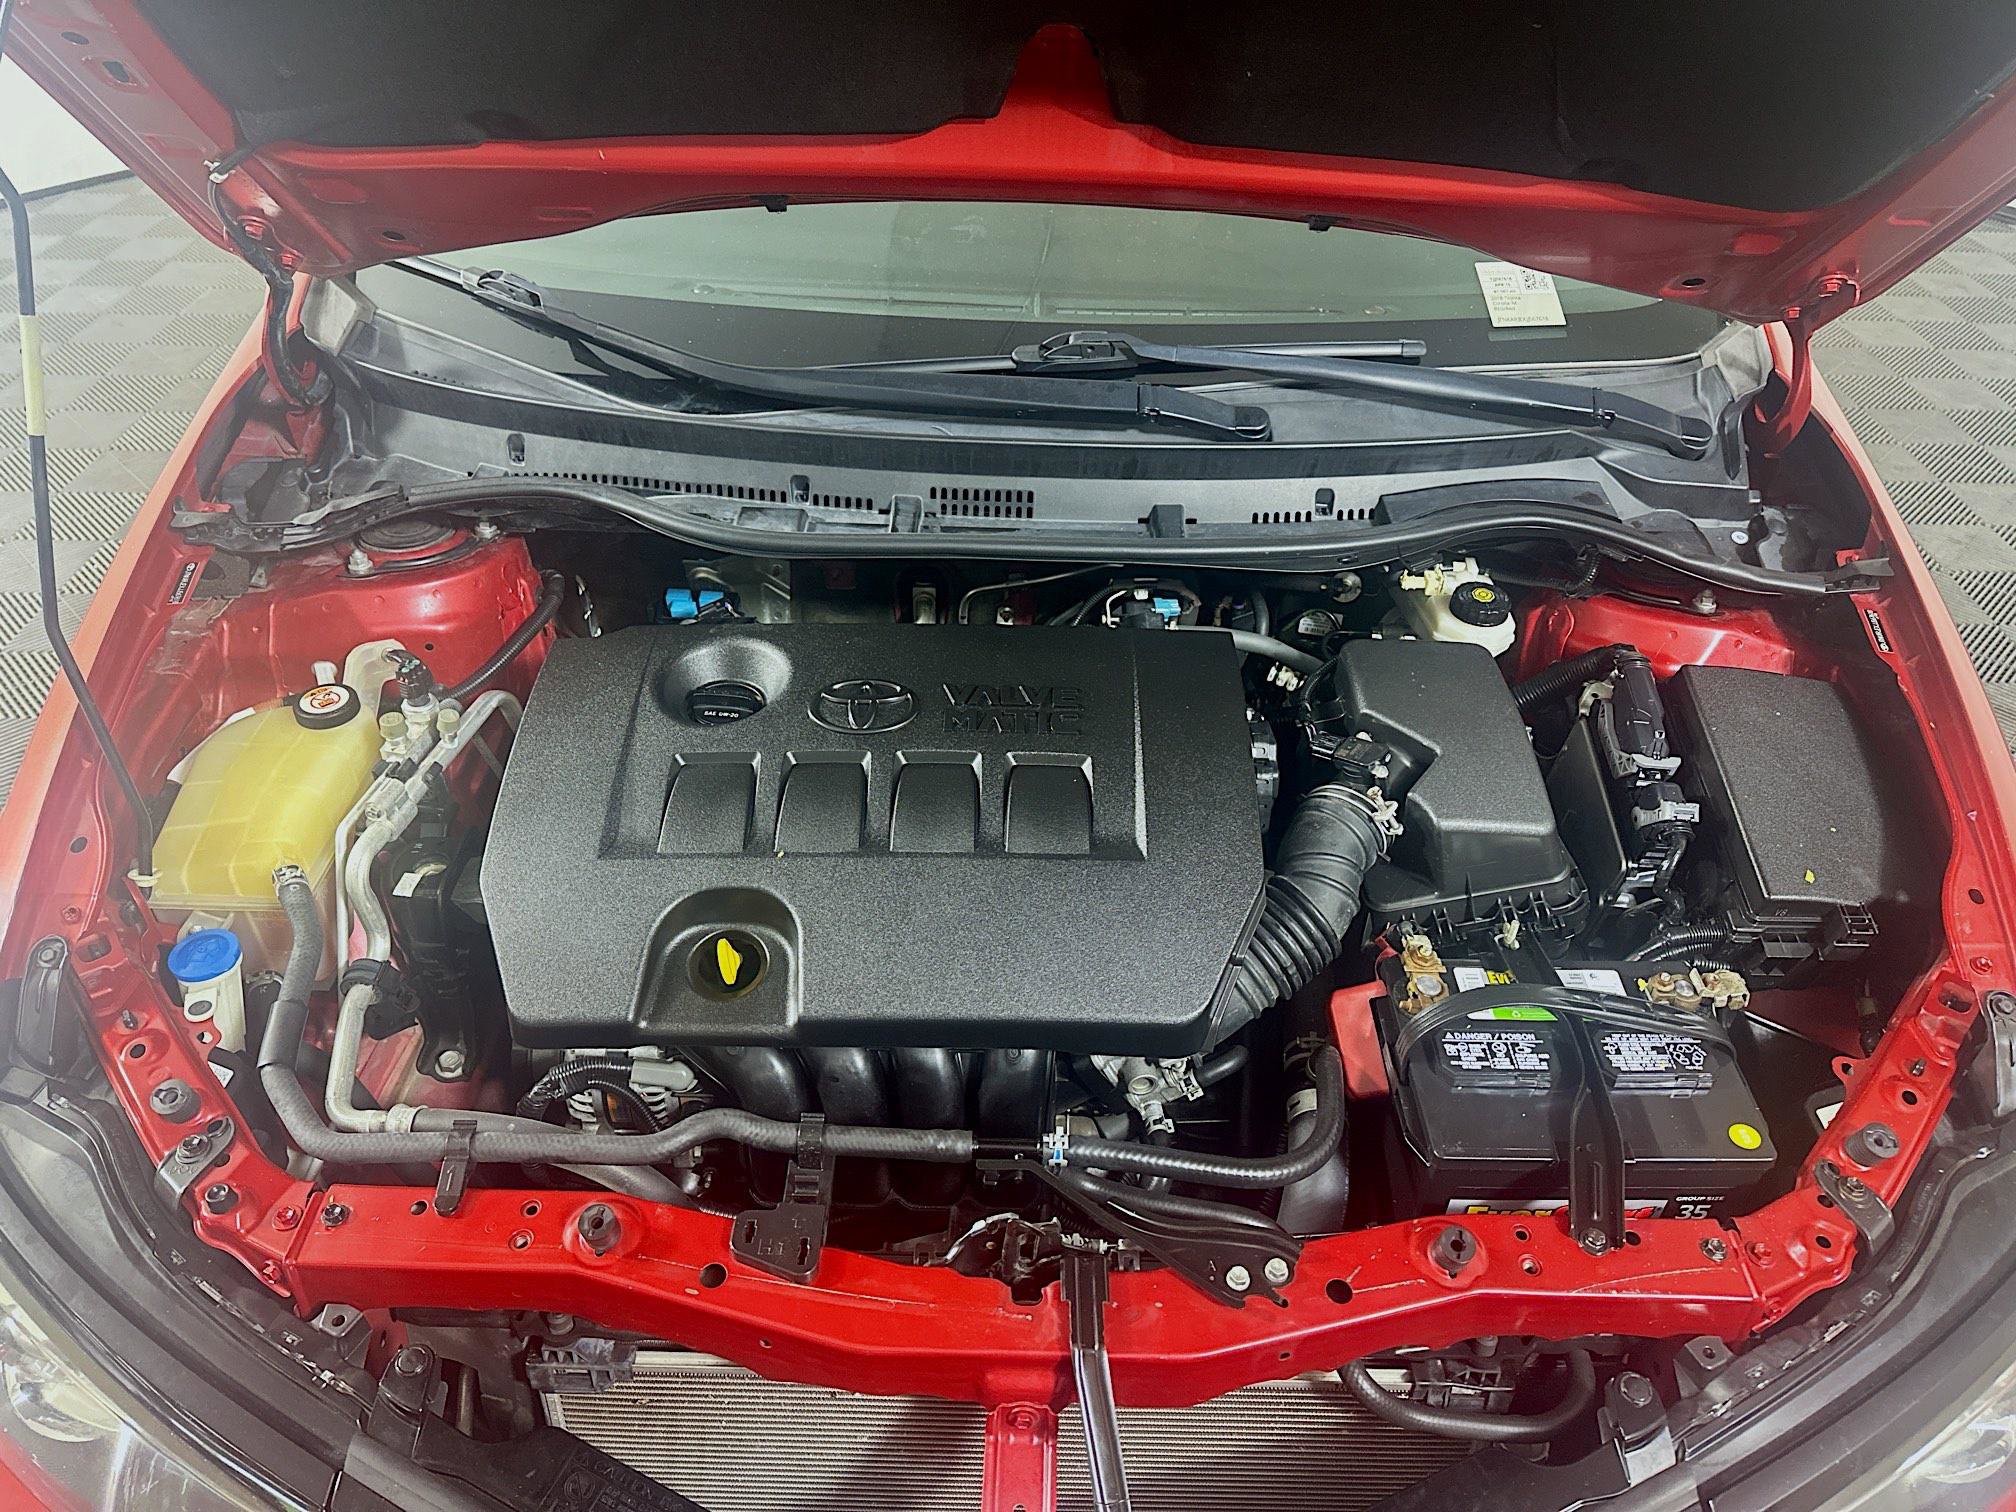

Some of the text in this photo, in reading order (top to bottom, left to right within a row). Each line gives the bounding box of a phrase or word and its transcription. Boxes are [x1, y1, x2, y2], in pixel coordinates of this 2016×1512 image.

[942, 683, 1082, 710] VALVE
[942, 711, 1082, 736] MATIC
[1453, 1032, 1493, 1040] DANGER
[1500, 1032, 1536, 1041] POISON
[1674, 1204, 1712, 1220] 35
